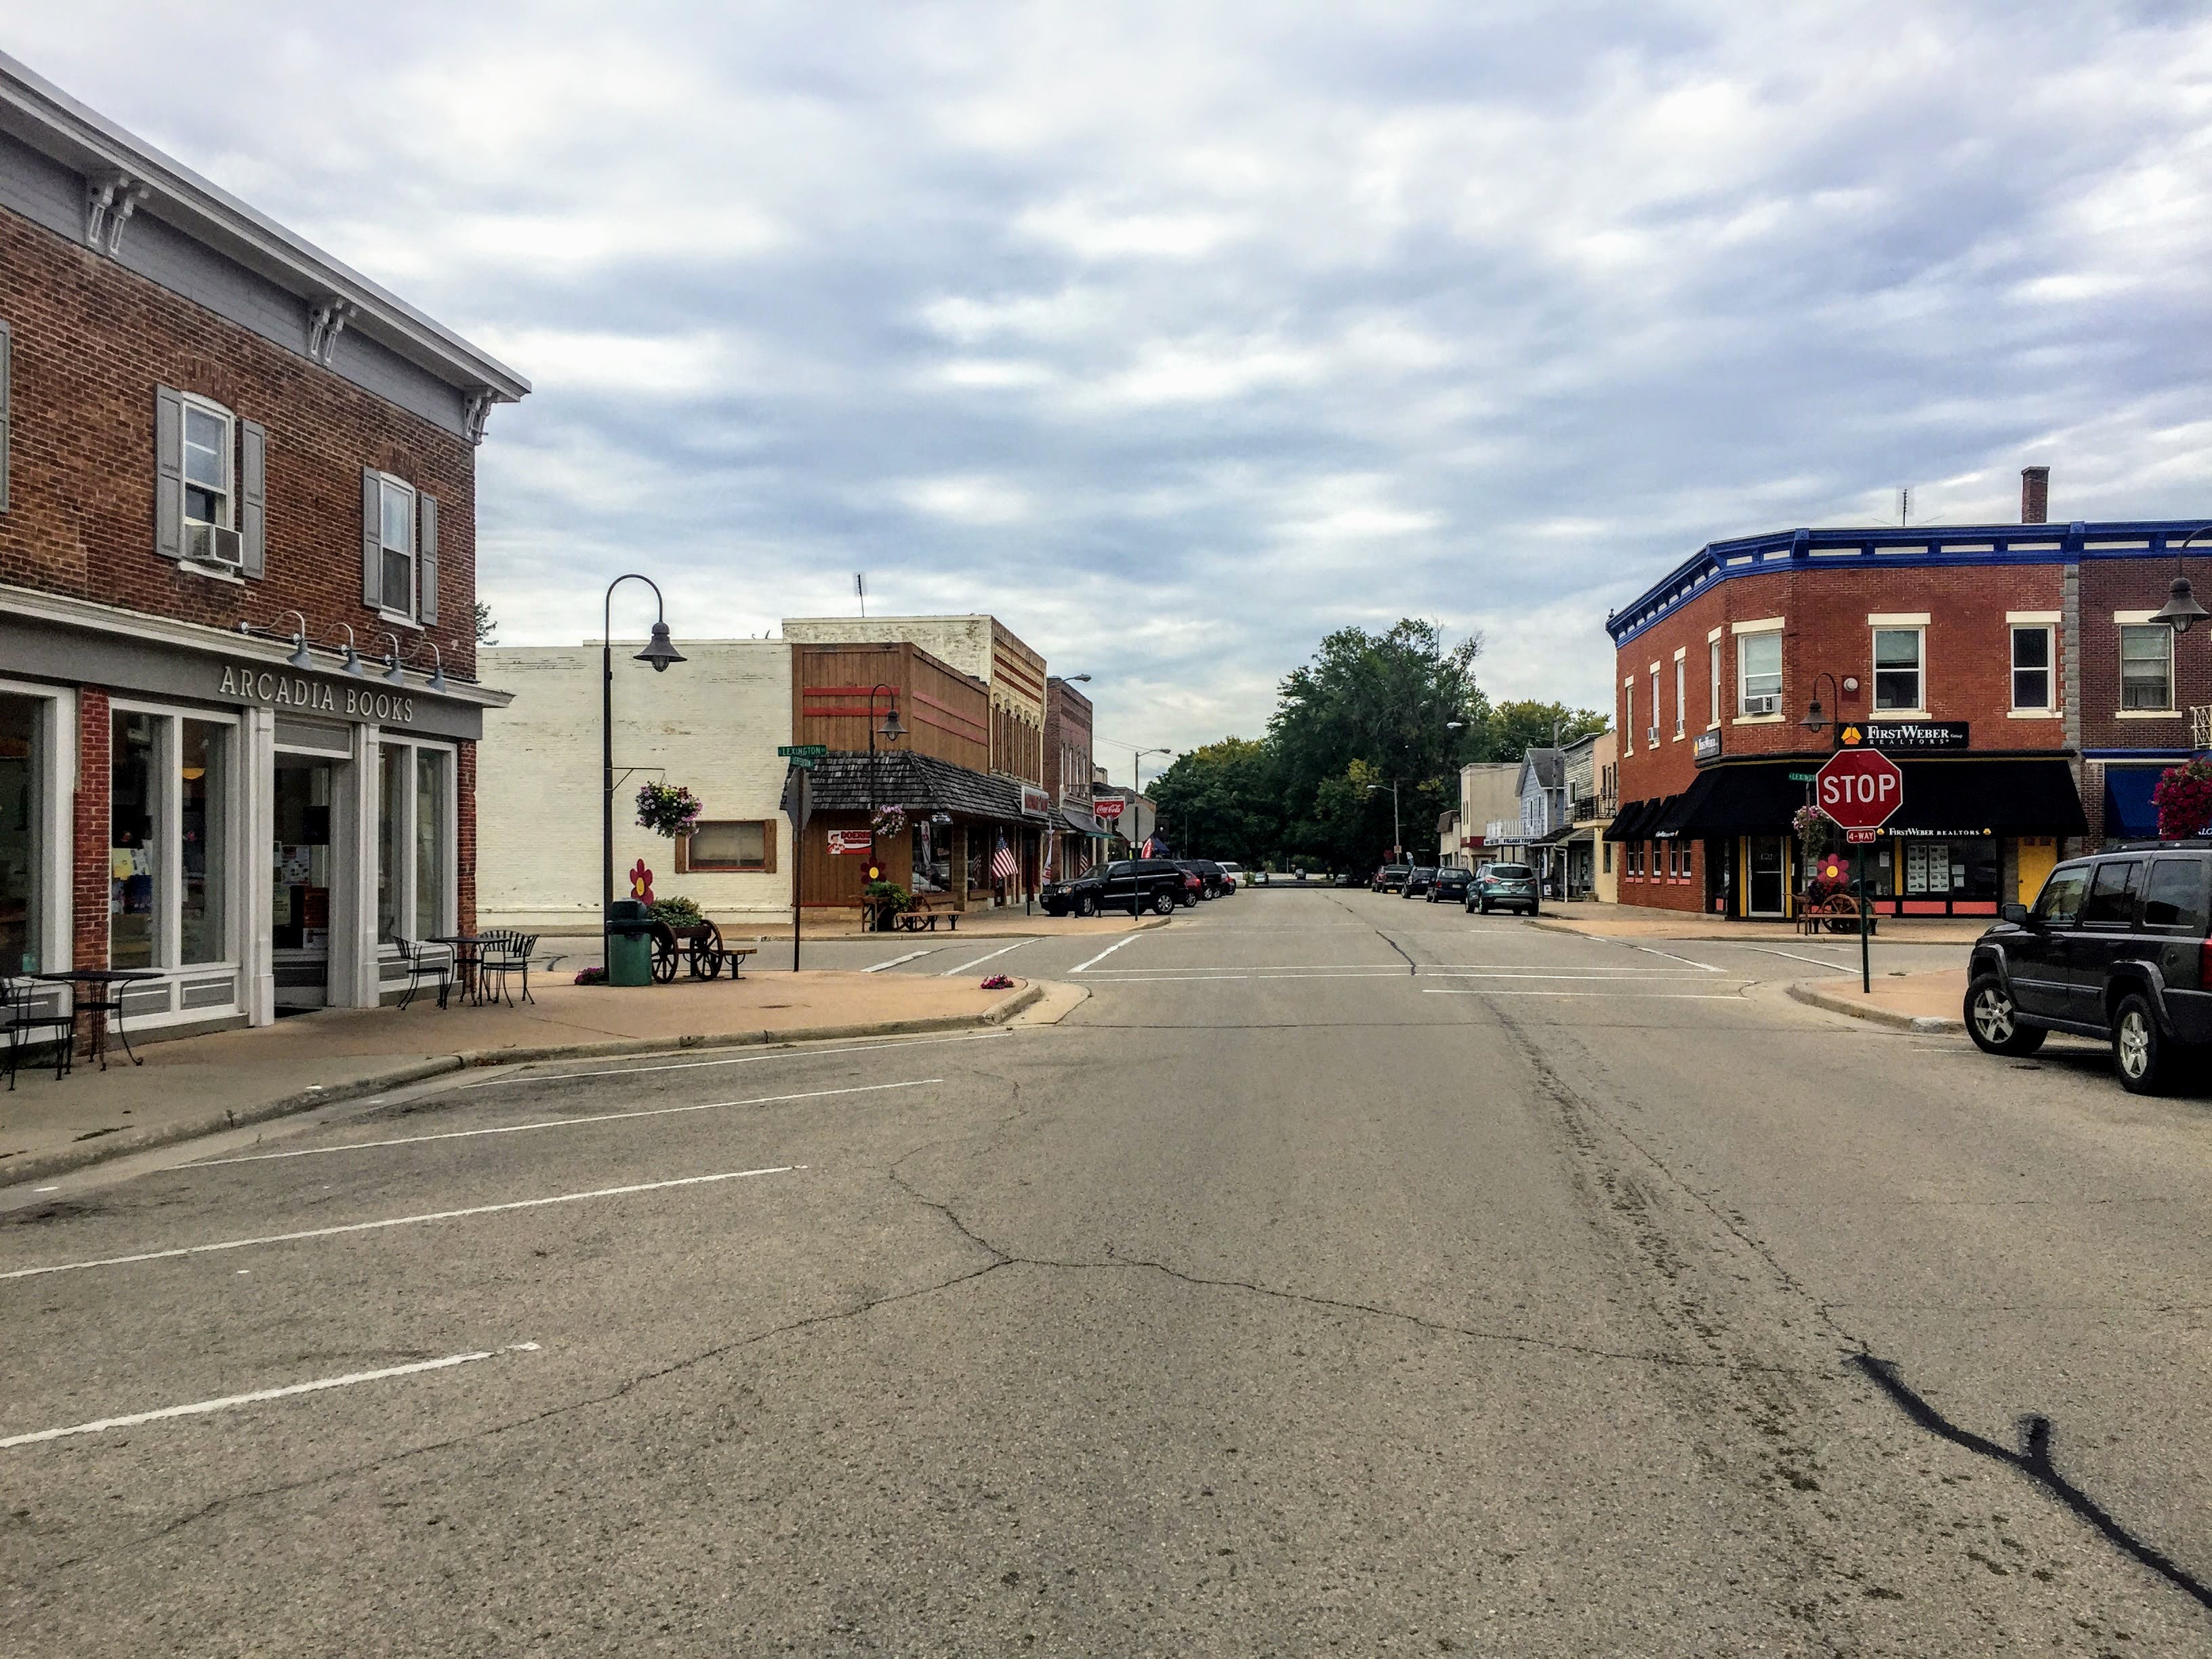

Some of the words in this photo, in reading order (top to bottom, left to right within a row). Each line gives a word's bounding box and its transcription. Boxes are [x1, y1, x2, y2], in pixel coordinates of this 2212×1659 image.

[219, 665, 334, 711] ARCADIA
[346, 689, 413, 722] BOOKS
[783, 747, 820, 755] LEXINGTON
[1792, 773, 1816, 781] LEXINGT
[1823, 774, 1896, 804] STOP
[1849, 832, 1873, 840] 4-WAY
